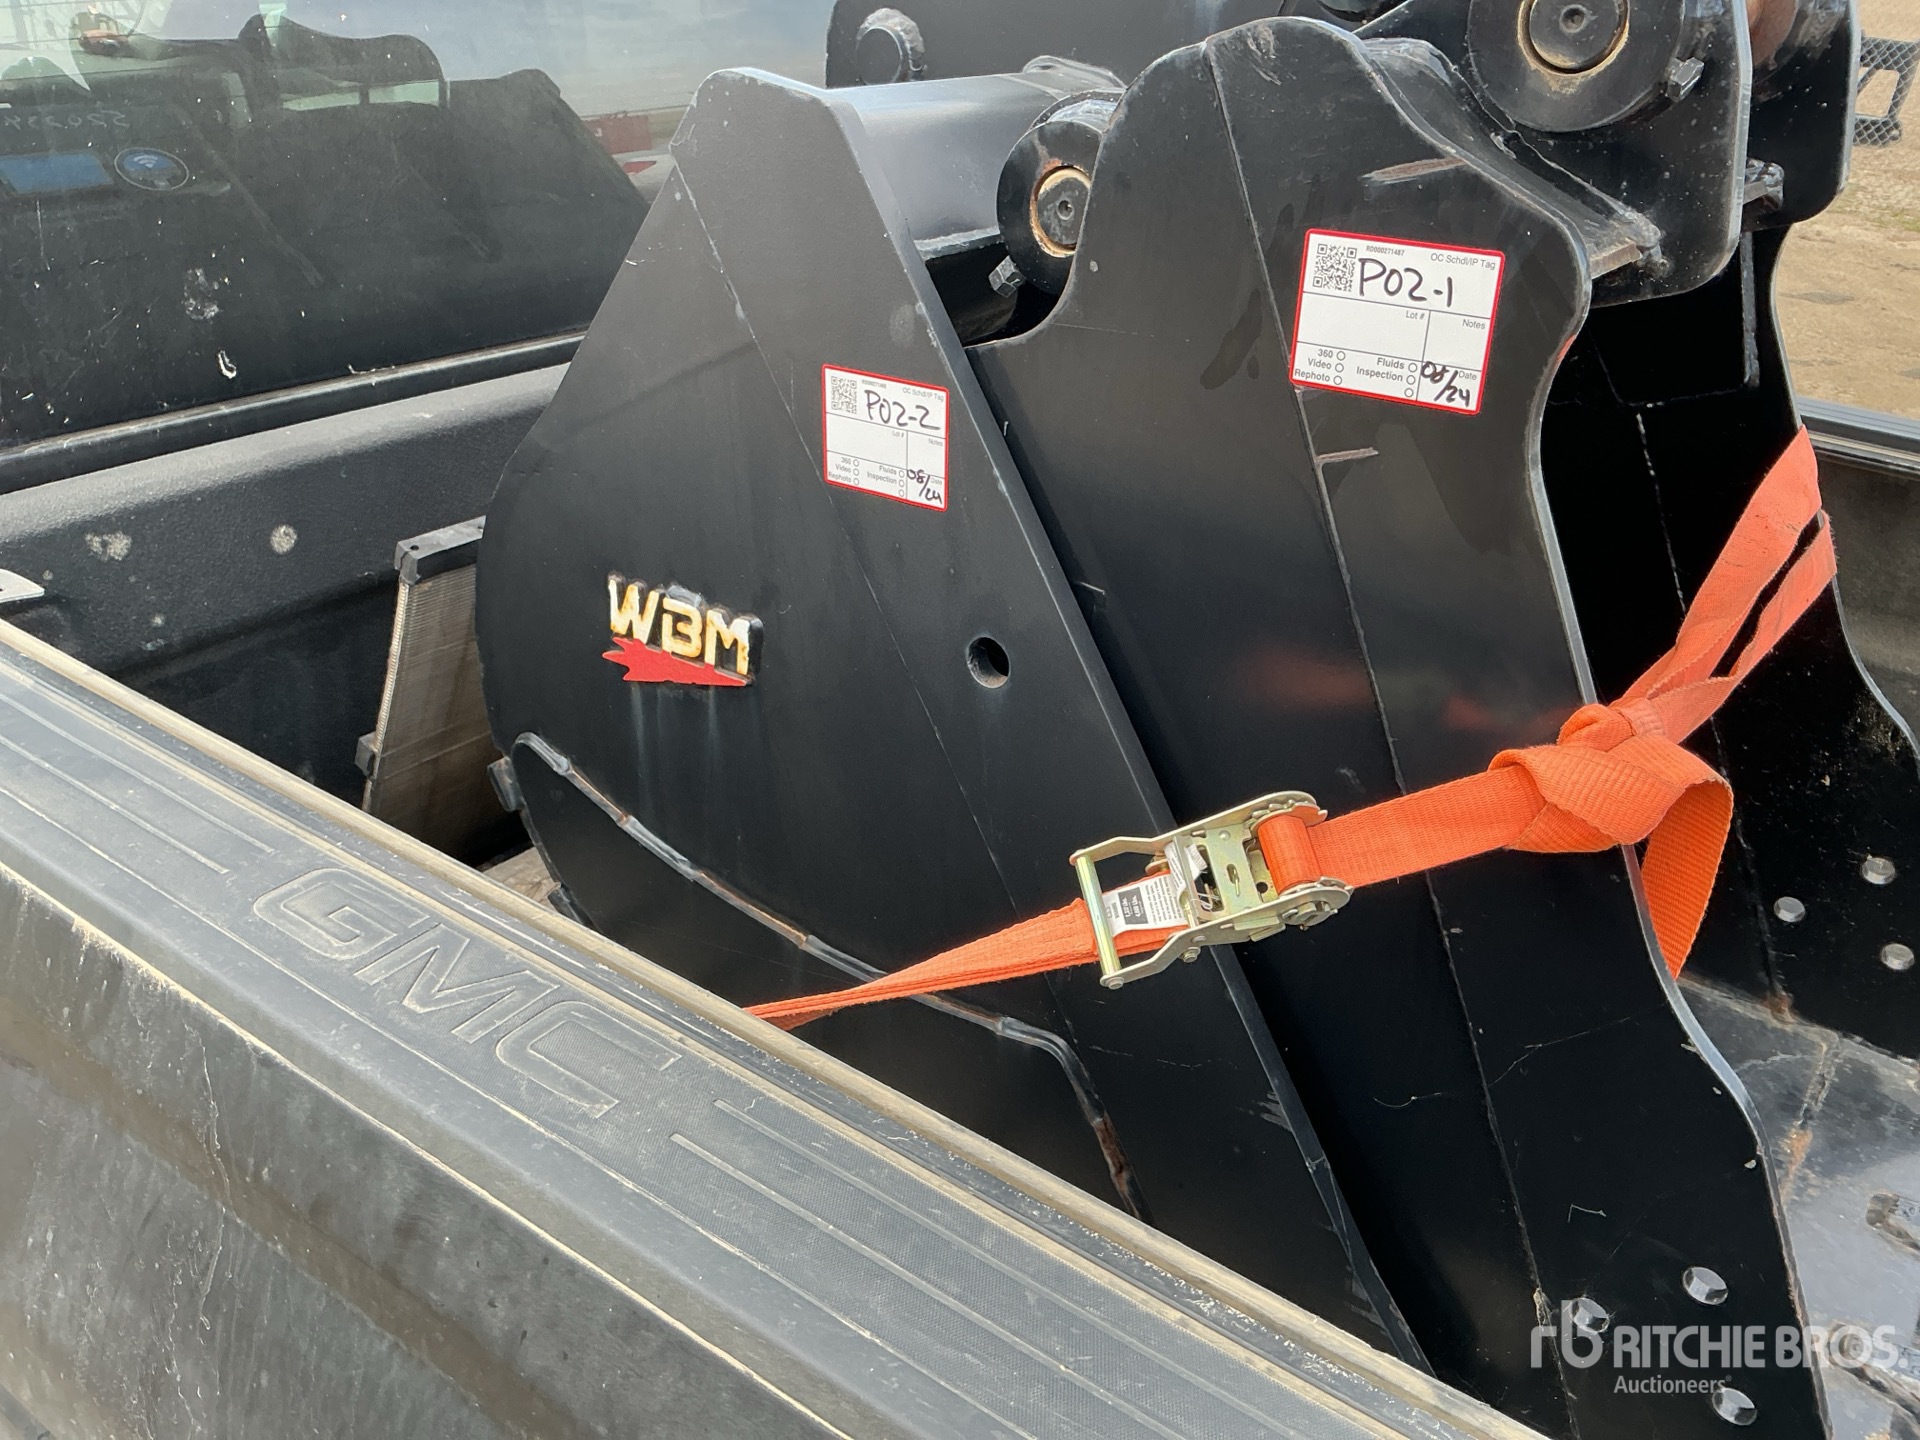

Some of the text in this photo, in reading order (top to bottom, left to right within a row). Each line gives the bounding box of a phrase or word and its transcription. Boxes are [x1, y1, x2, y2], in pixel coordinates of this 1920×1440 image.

[1430, 253, 1445, 263] OC
[1481, 259, 1496, 271] Tag
[1358, 258, 1453, 308] P02-1
[1405, 310, 1418, 320] Lot
[1462, 319, 1486, 330] Notes
[1317, 348, 1334, 358] 360
[1307, 358, 1332, 370] Video
[1377, 357, 1405, 370] Fluids
[1294, 369, 1331, 382] Rephoto
[1356, 366, 1403, 382] Inspection
[1459, 370, 1477, 381] Date
[864, 389, 941, 431] P02-2
[928, 438, 943, 447] Notes
[835, 463, 852, 473] Video
[879, 465, 897, 476] Fluids
[867, 471, 897, 485] Inspection
[606, 578, 750, 676] WBM
[253, 867, 683, 1119] GMC
